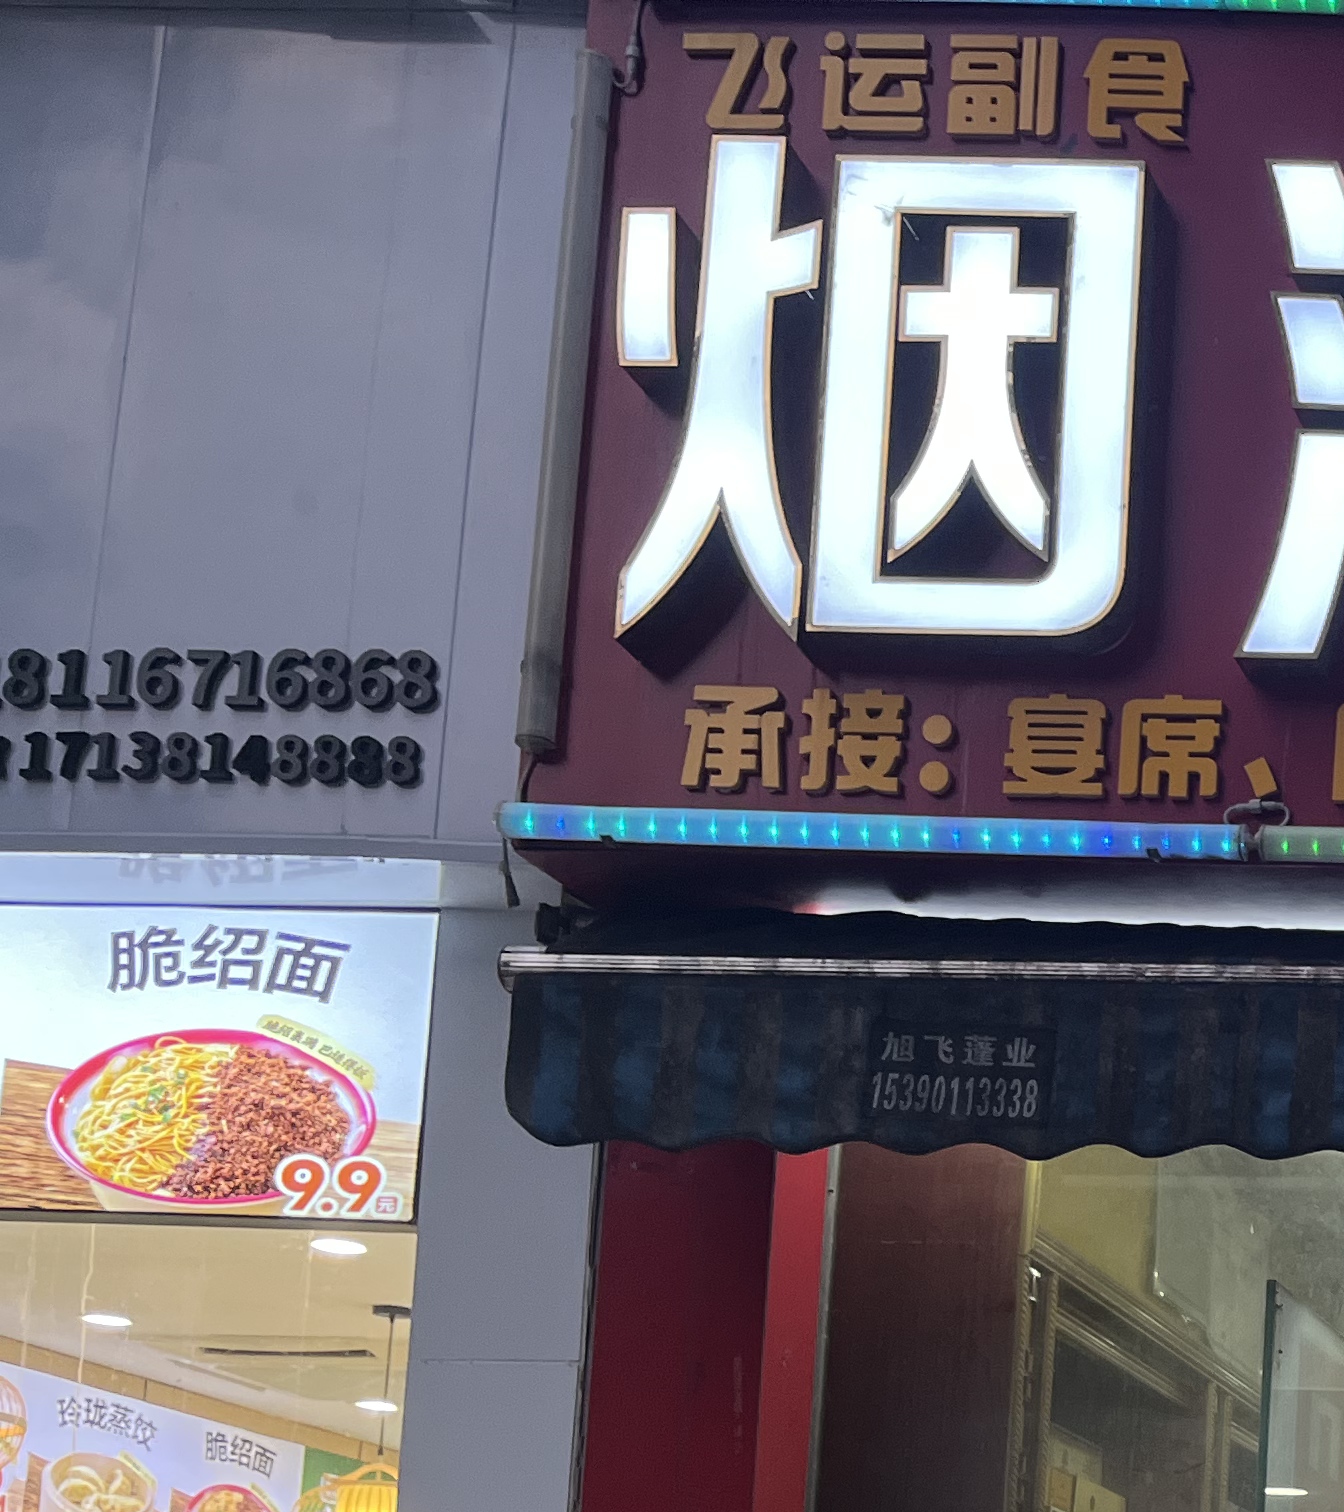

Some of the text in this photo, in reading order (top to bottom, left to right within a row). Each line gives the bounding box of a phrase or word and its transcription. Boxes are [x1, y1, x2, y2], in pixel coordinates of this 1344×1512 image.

[682, 30, 1192, 145] 飞运副食
[0, 647, 443, 714] 8116716868
[107, 925, 351, 1004] 脆绍面
[277, 1155, 386, 1216] 9.9
[57, 1395, 158, 1452] 玲珑蒸饺
[205, 1430, 277, 1479] 脆绍面
